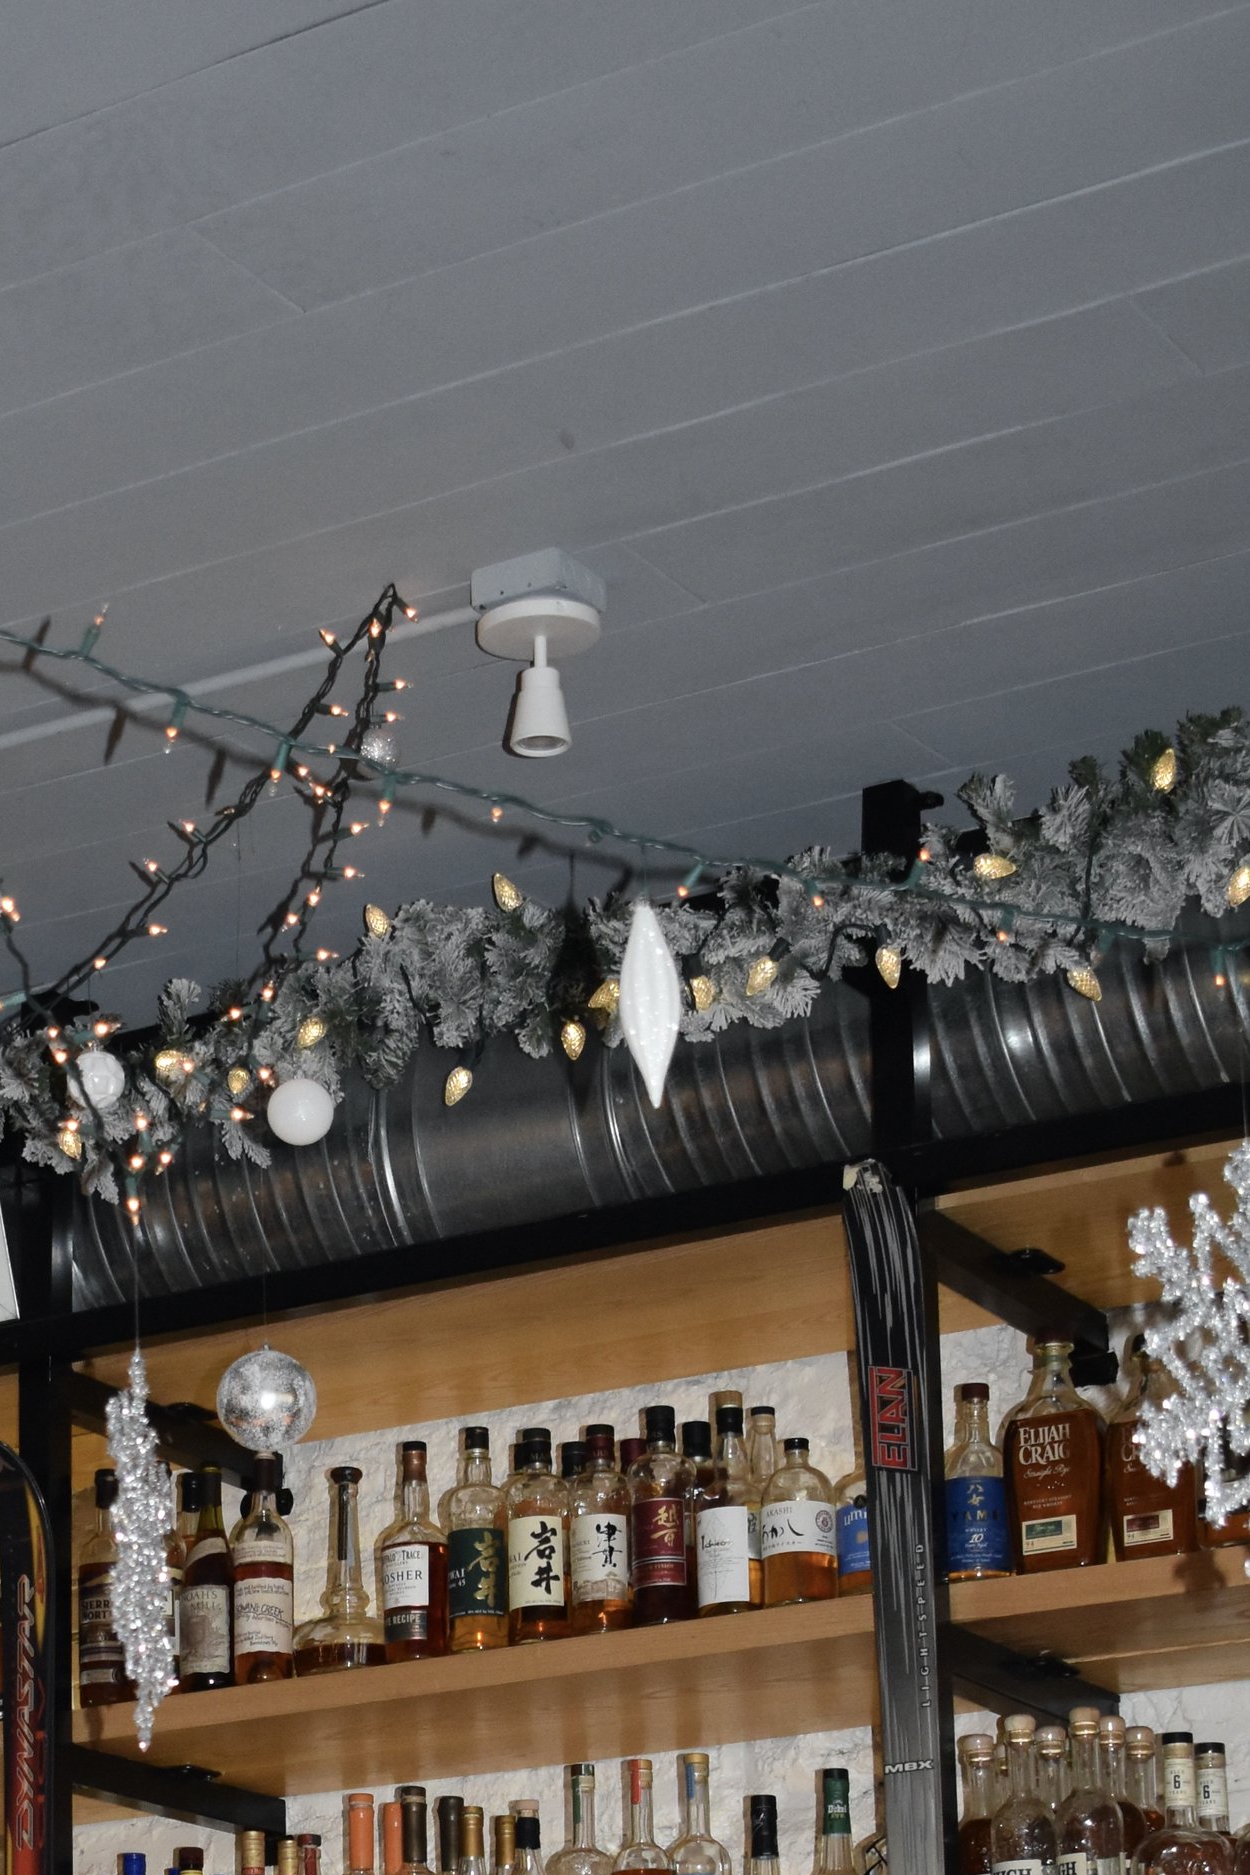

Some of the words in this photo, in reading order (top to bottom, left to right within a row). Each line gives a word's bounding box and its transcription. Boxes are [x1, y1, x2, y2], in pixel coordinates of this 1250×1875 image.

[873, 1366, 911, 1470] ELAN
[1018, 1423, 1070, 1446] ELIJAH
[1018, 1442, 1070, 1465] CRAIG
[765, 1505, 793, 1518] AKASHI
[969, 1532, 984, 1543] 10
[524, 1520, 561, 1595] 岩井
[382, 1570, 423, 1584] OSHER
[261, 1604, 285, 1618] CREEK
[393, 1613, 422, 1625] RECIPE
[916, 1543, 931, 1708] LIGHTSPEED
[16, 1574, 35, 1851] DYNASTAR
[884, 1759, 935, 1774] MBX
[1172, 1774, 1181, 1789] 6
[1203, 1785, 1211, 1799] 6
